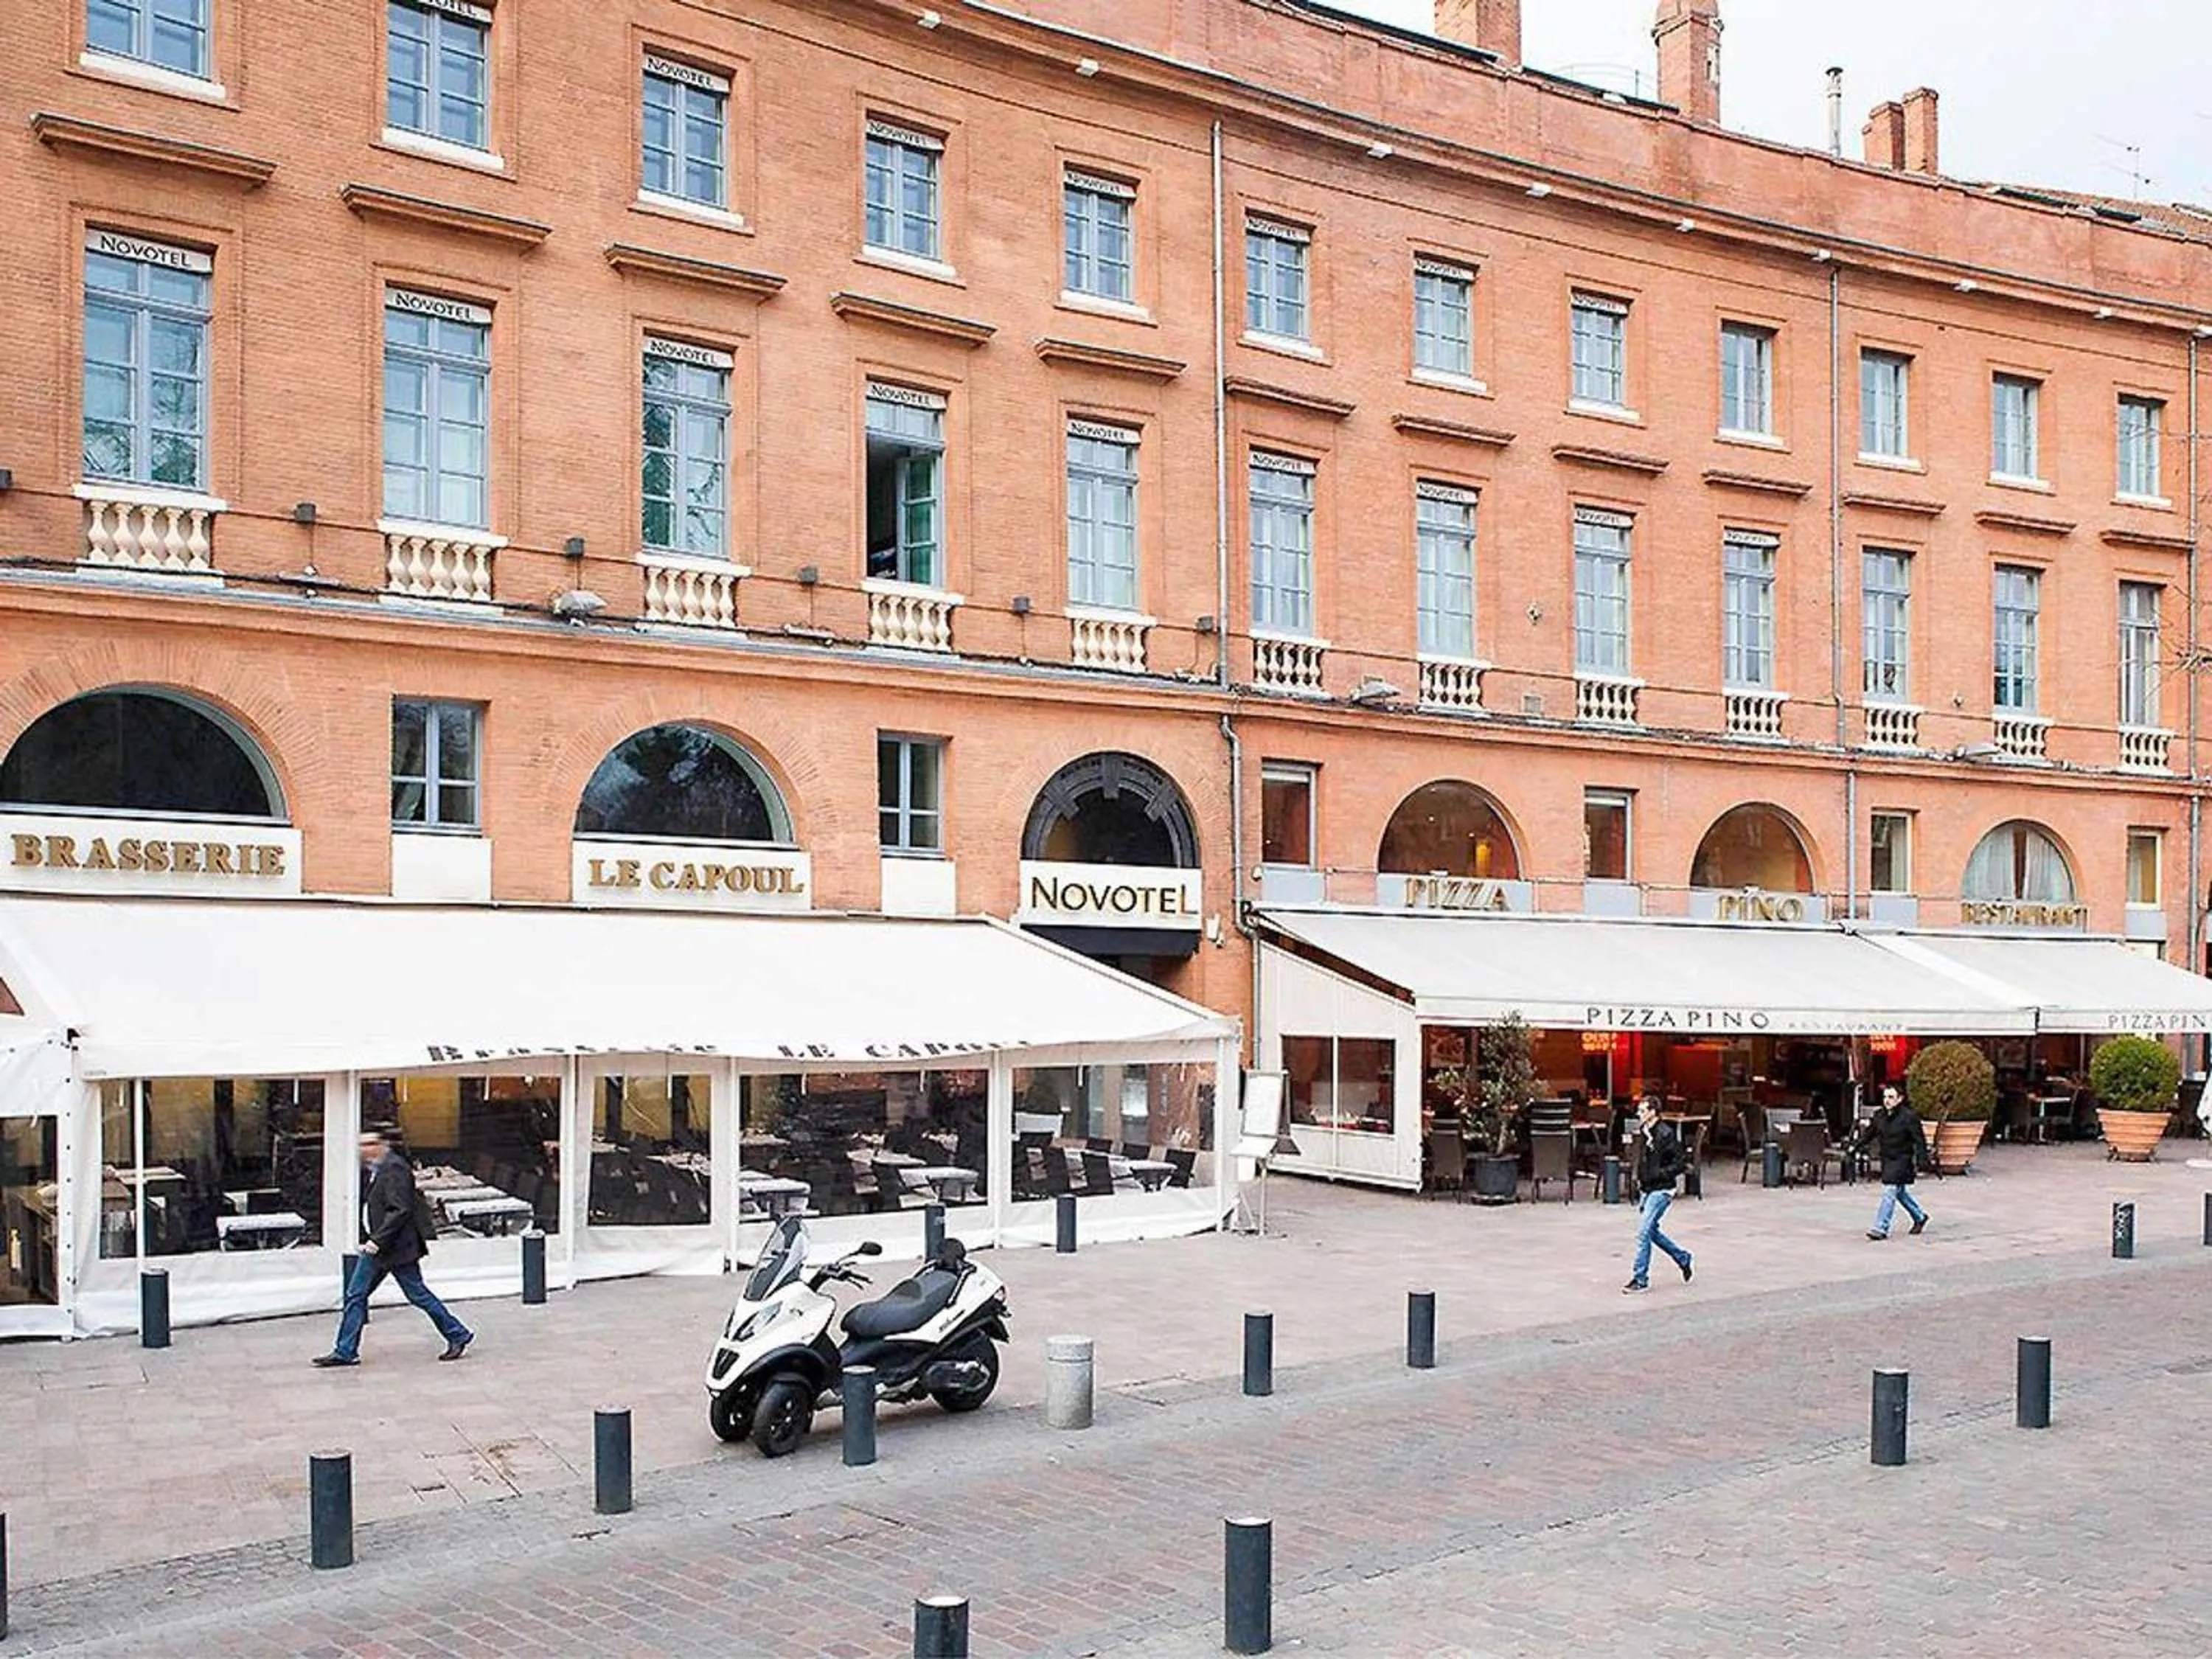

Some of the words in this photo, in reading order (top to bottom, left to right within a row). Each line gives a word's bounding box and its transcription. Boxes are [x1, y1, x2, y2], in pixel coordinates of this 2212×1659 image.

[647, 57, 714, 88] NOVOTEL
[870, 121, 927, 146] NOVOTEL
[100, 234, 192, 268] NOVOTEL
[395, 291, 473, 321] NOVOTEL
[650, 338, 716, 365] NOVOTEL
[872, 383, 930, 406] NOVOTEL
[1071, 422, 1125, 441] NOVOTEL
[10, 834, 285, 875] BRASSERIE
[588, 858, 641, 888] LE
[649, 861, 804, 894] CAPOUL
[1031, 875, 1200, 914] NOVOTEL
[1405, 877, 1510, 911] PIZZA
[1717, 894, 1803, 922] PINO
[1587, 1007, 1676, 1028] PIZZA
[1687, 1009, 1770, 1029] PINO
[2108, 1013, 2166, 1029] PIZZA
[2169, 1014, 2212, 1030] PIN
